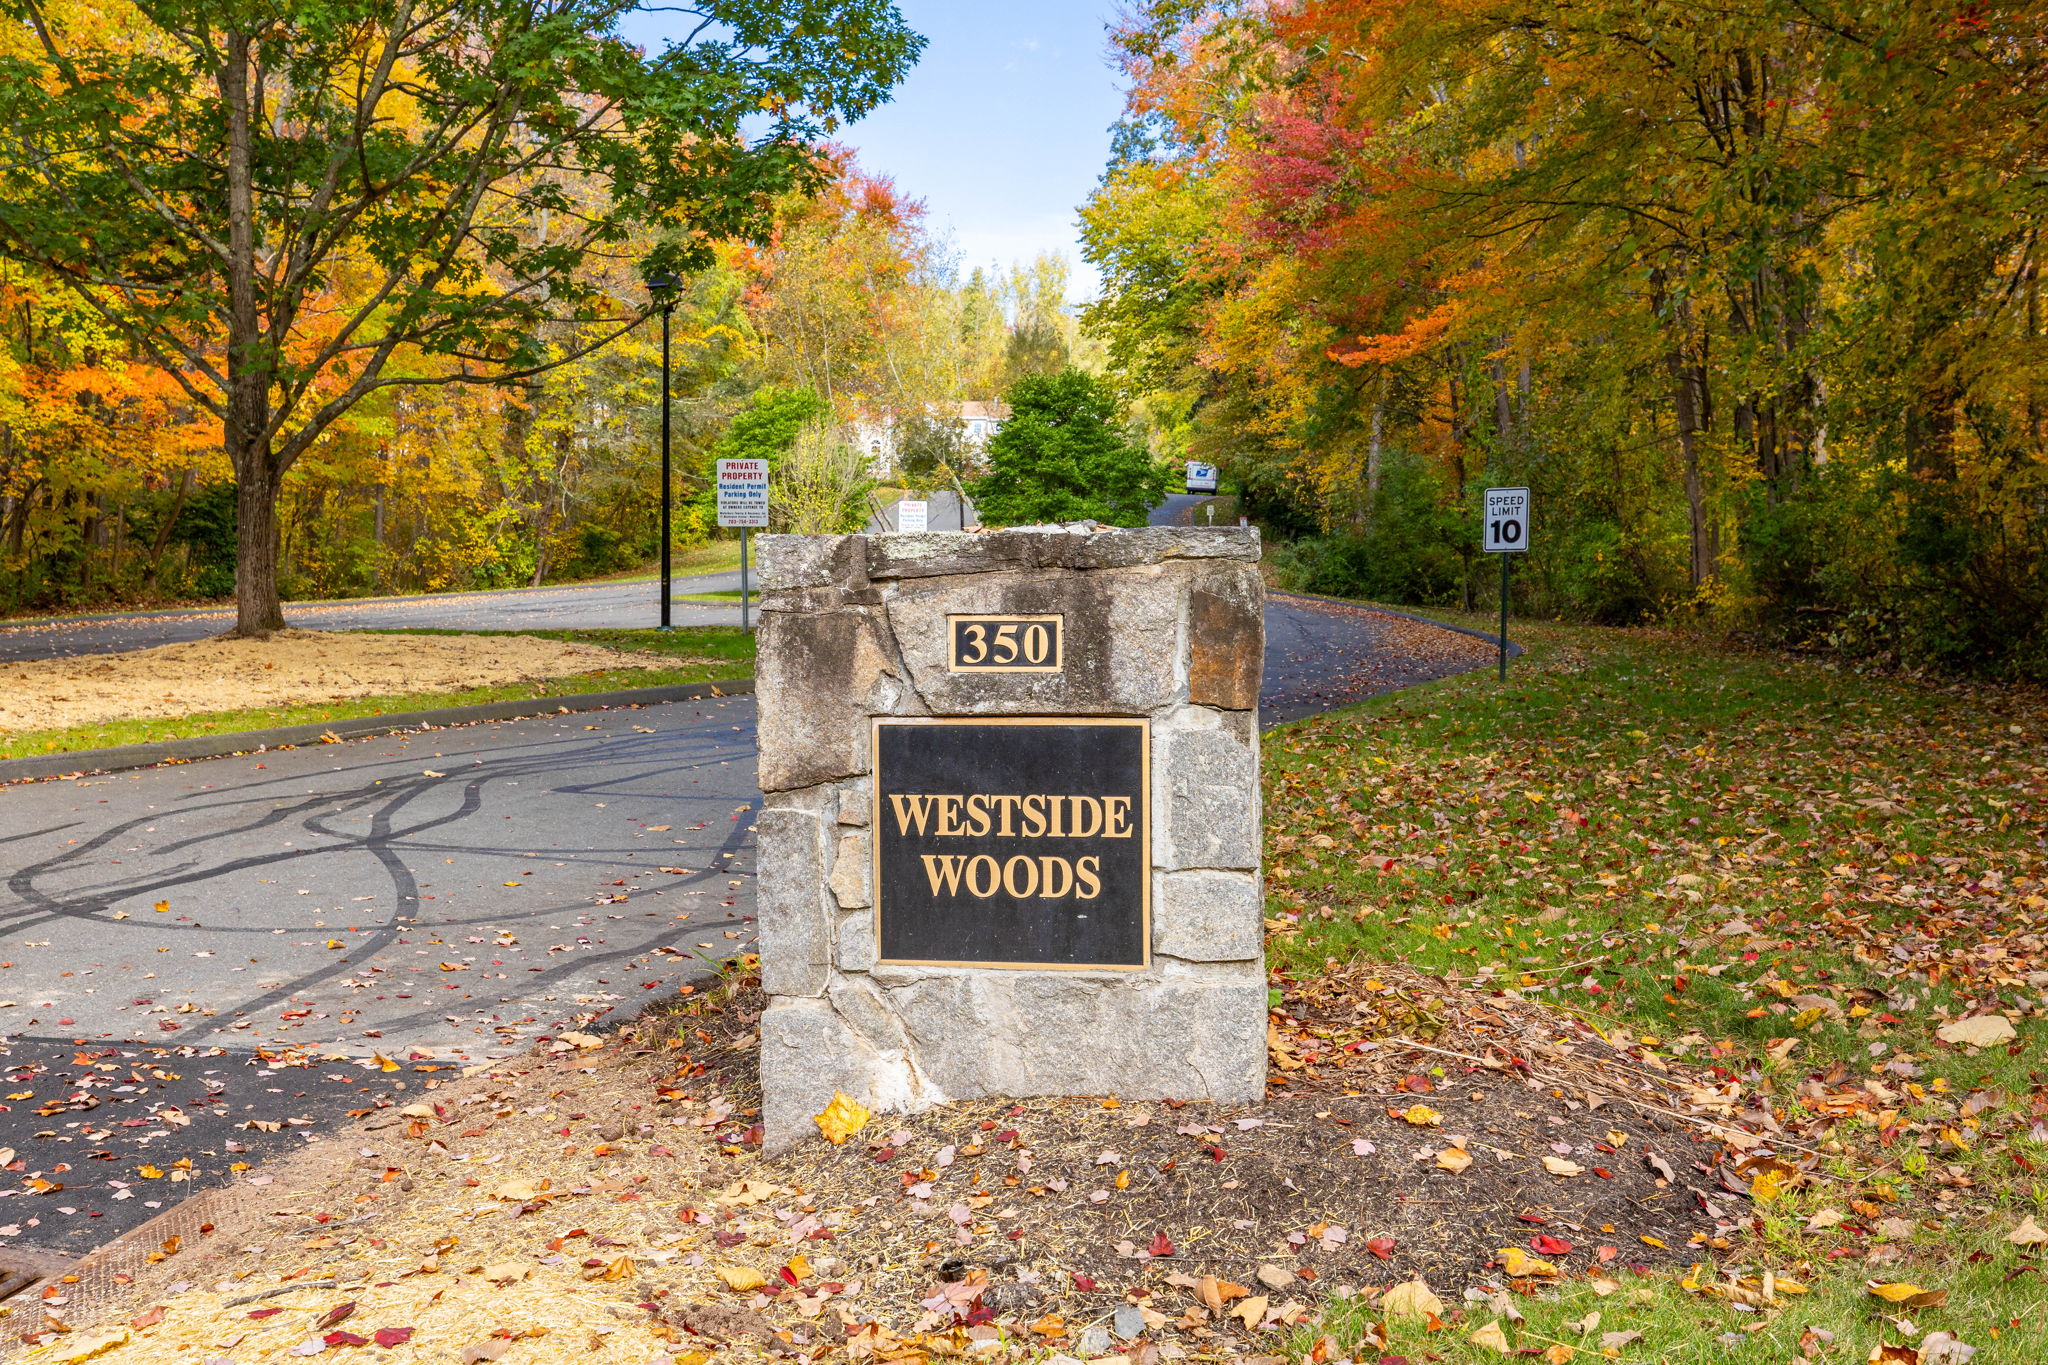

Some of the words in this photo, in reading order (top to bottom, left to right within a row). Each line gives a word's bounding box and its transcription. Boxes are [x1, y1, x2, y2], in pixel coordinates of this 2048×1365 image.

[726, 462, 759, 470] PRIVATE
[721, 472, 763, 480] PROPERTY
[724, 491, 747, 499] Parking
[1489, 496, 1524, 506] SPEED
[1492, 506, 1521, 516] LIMIT
[1490, 519, 1522, 544] 10
[962, 624, 1049, 664] 350
[888, 794, 1134, 839] WESTSIDE
[920, 854, 1102, 900] WOODS
